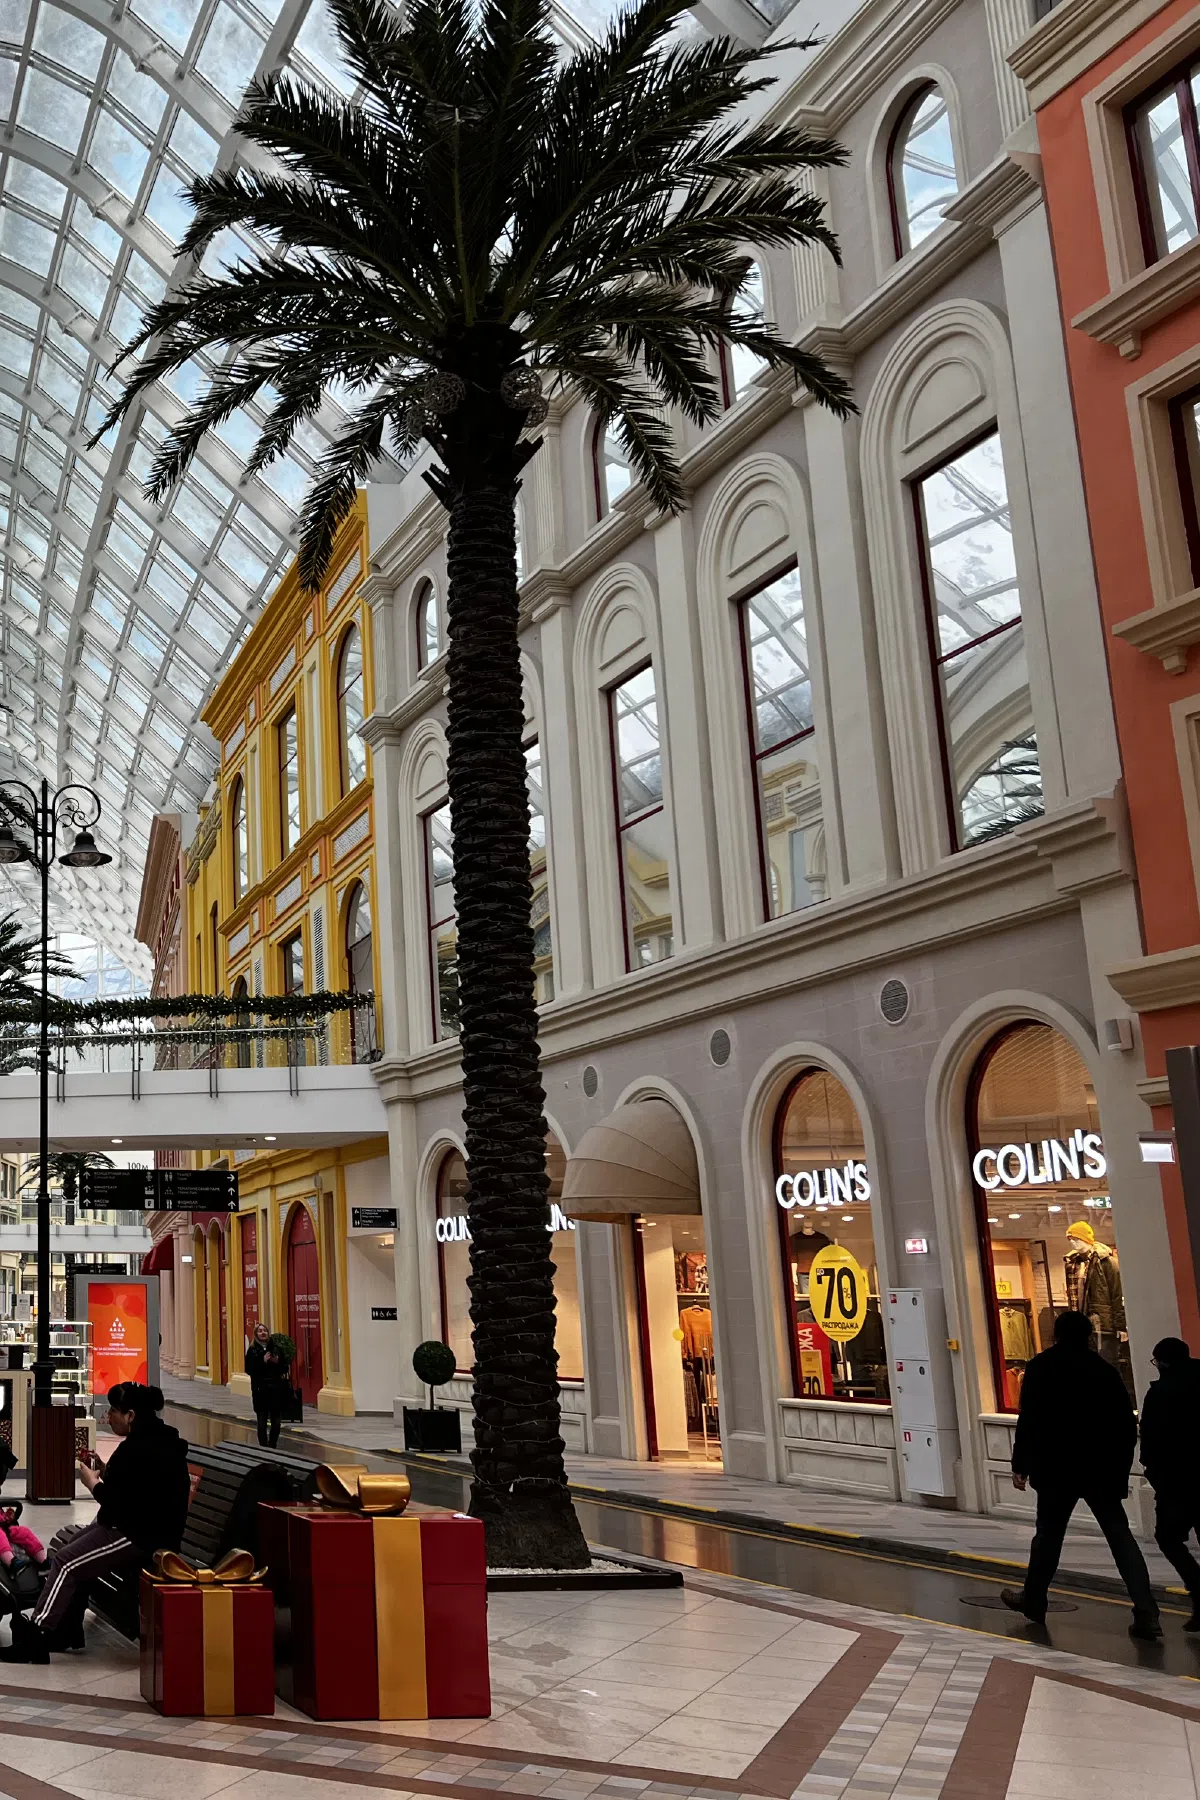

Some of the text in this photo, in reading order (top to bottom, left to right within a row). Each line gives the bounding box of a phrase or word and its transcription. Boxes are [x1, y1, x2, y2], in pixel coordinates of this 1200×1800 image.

[776, 1159, 871, 1209] COLIN'S
[973, 1128, 1107, 1190] COLIN'S
[436, 1215, 472, 1243] COLIN
[815, 1267, 858, 1319] 70
[822, 1321, 859, 1330] РАСПРОДАЖА
